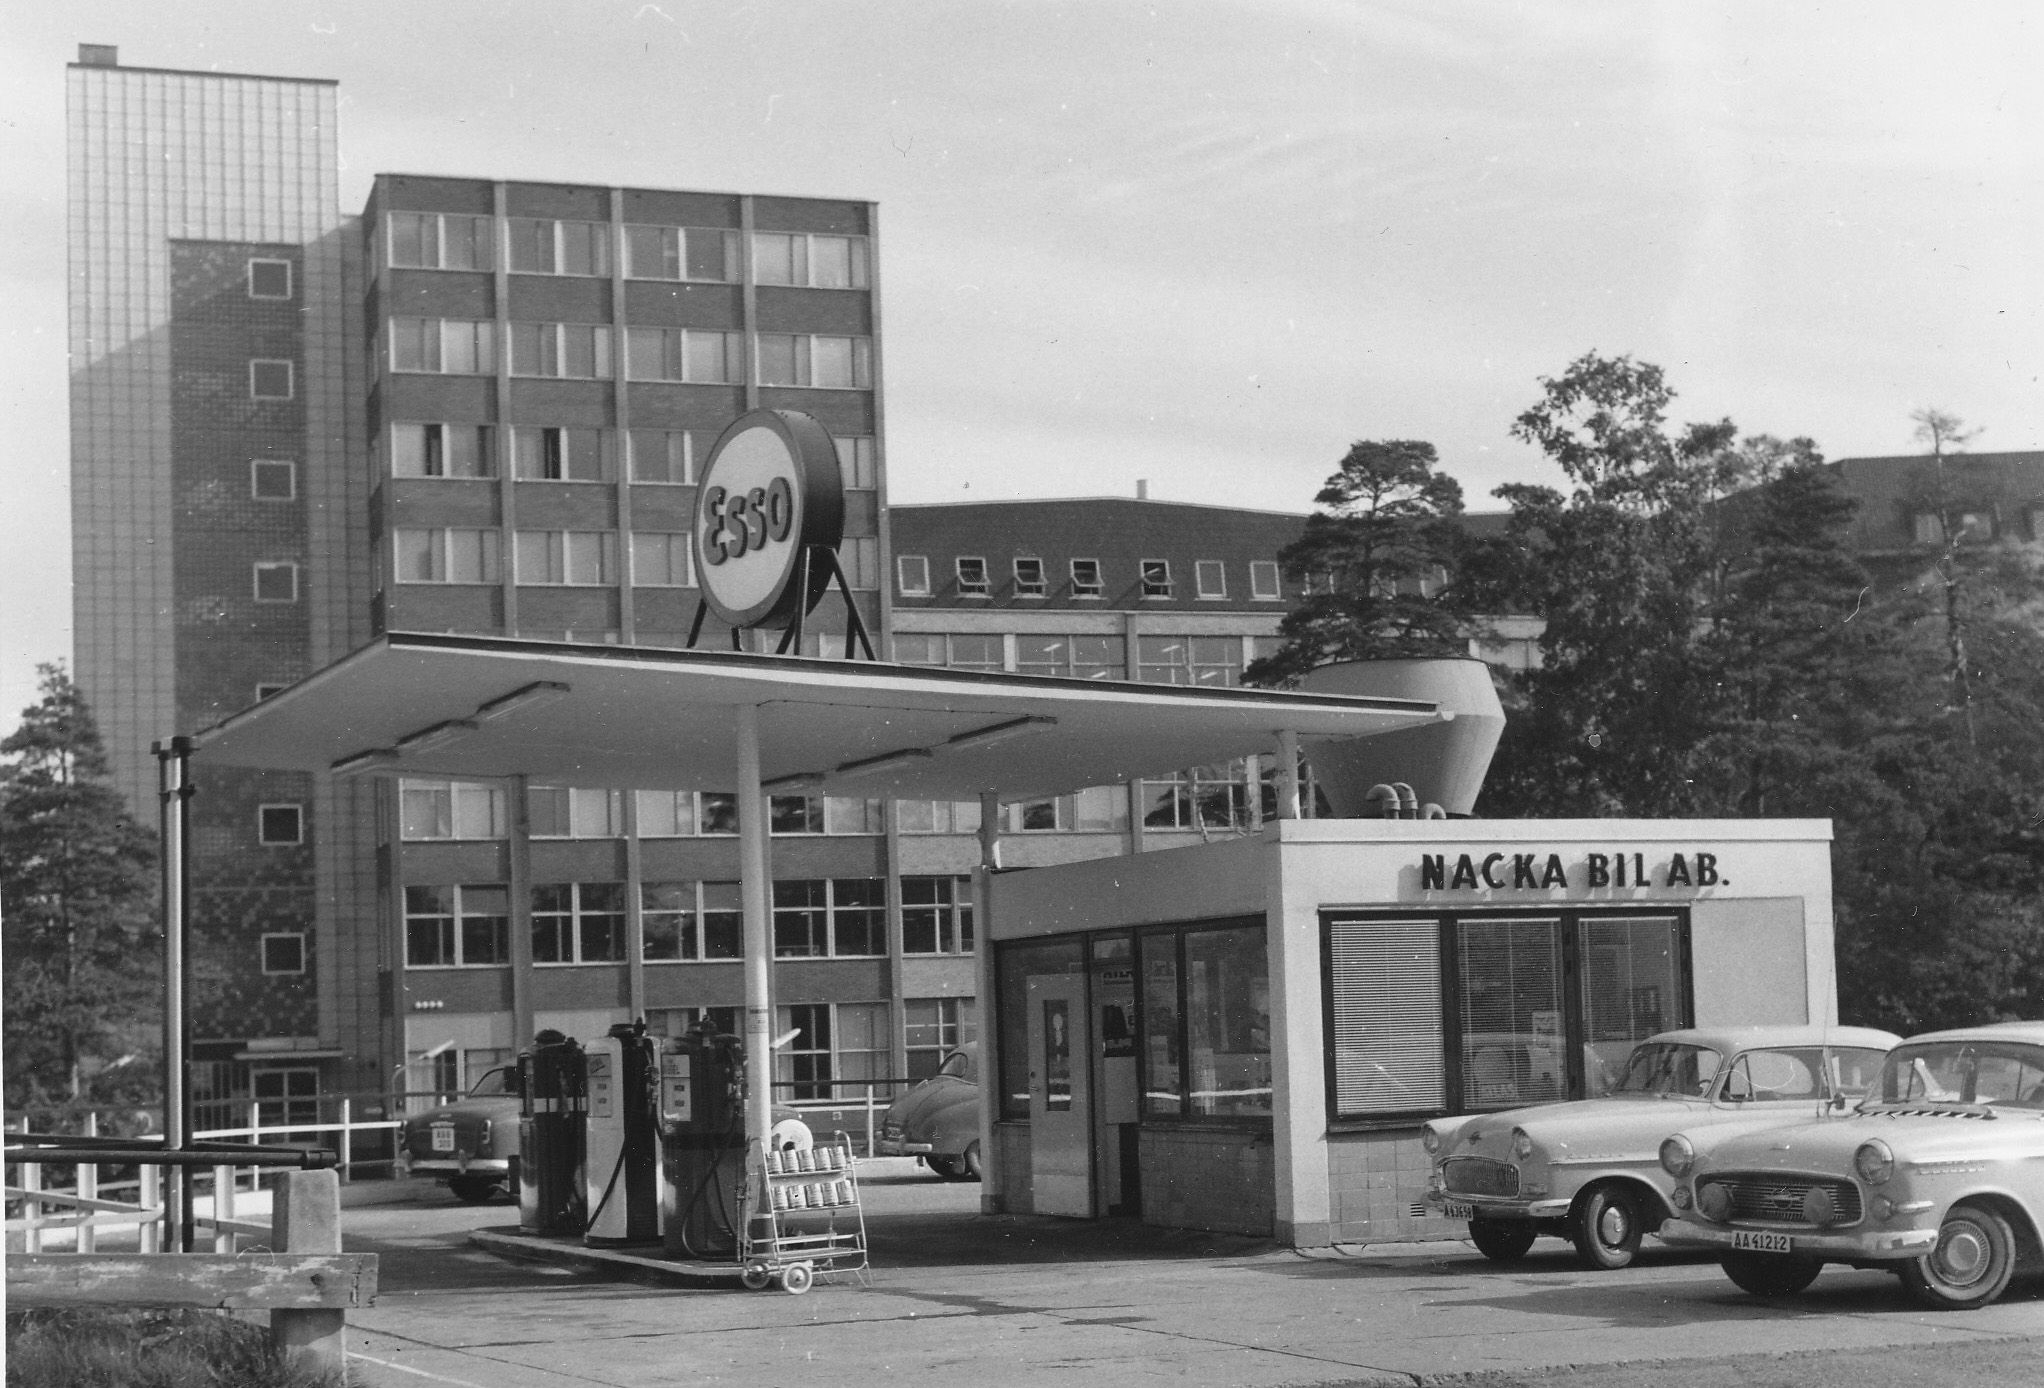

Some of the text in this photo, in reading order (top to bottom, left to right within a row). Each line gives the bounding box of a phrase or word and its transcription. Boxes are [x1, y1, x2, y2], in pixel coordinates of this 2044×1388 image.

[1422, 852, 1731, 890] NACKA BIL AB.
